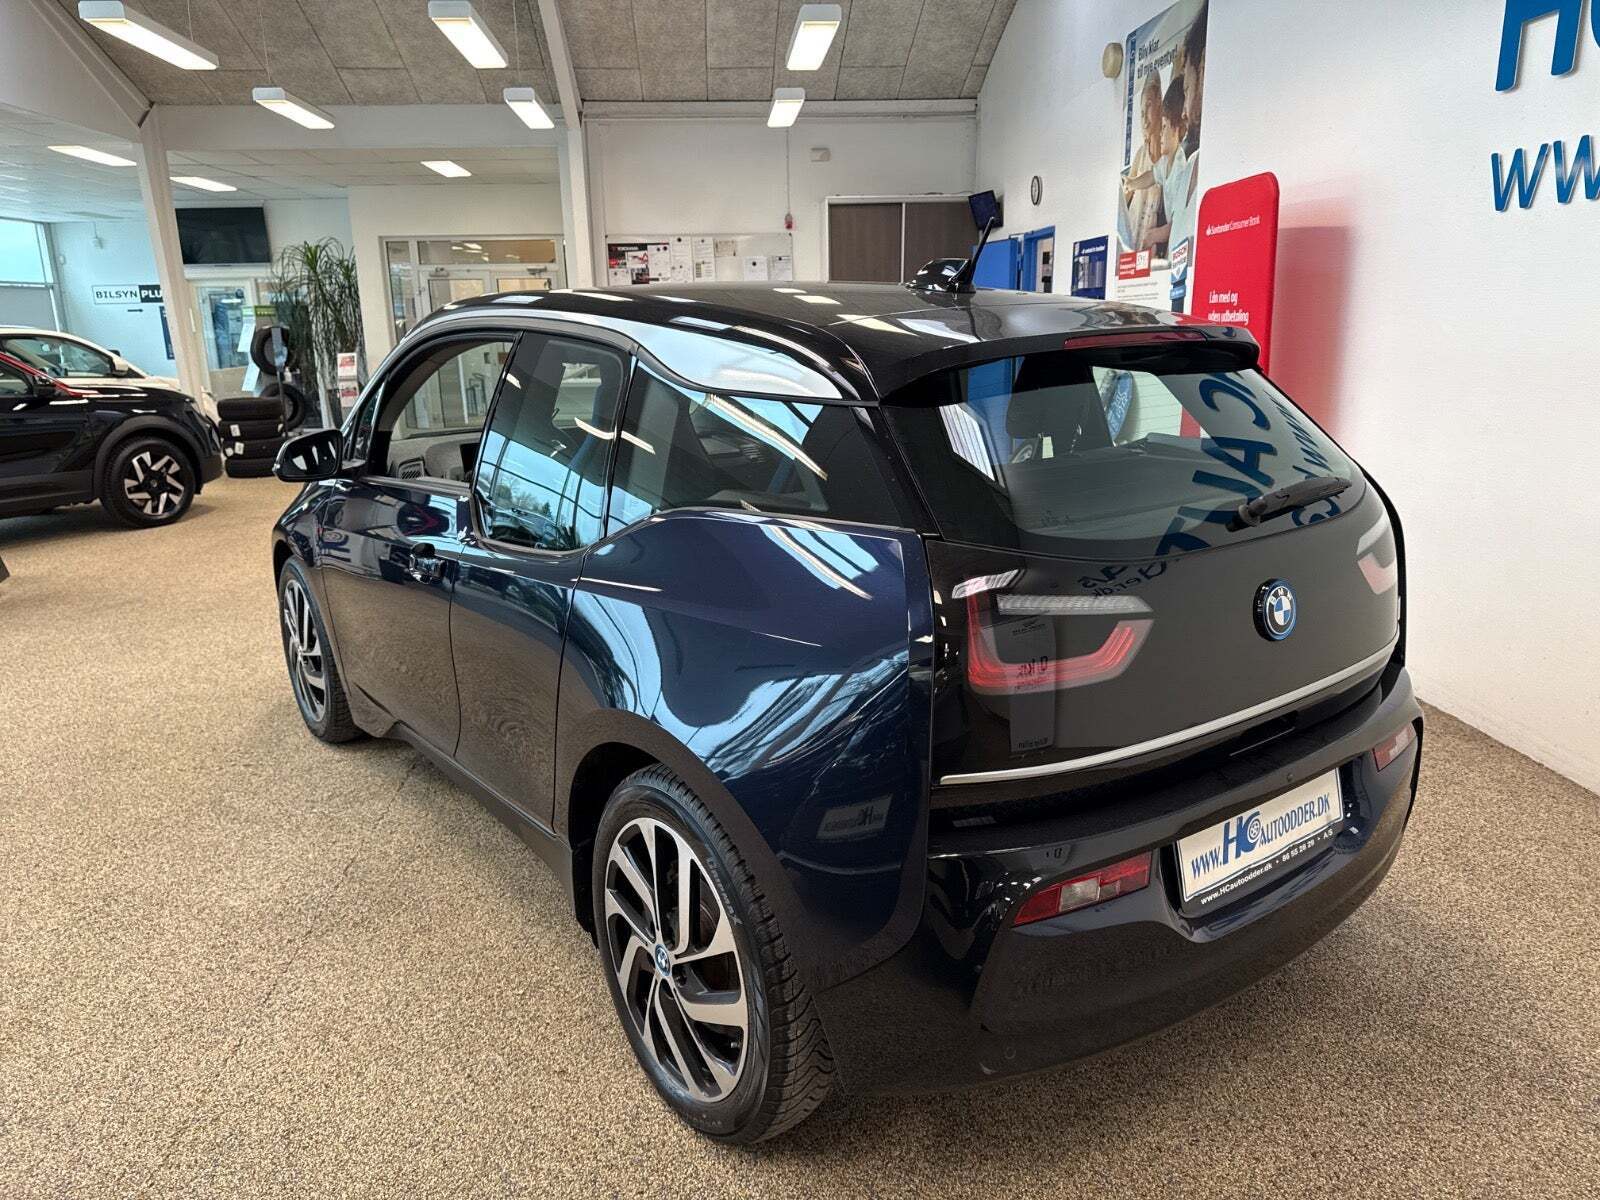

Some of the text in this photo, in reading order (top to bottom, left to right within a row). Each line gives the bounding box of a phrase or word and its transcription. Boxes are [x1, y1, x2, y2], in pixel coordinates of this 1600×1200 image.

[95, 289, 163, 299] BILSYN PLU
[1219, 290, 1230, 303] med
[1200, 862, 1273, 905] www.HCautoodder.dk
